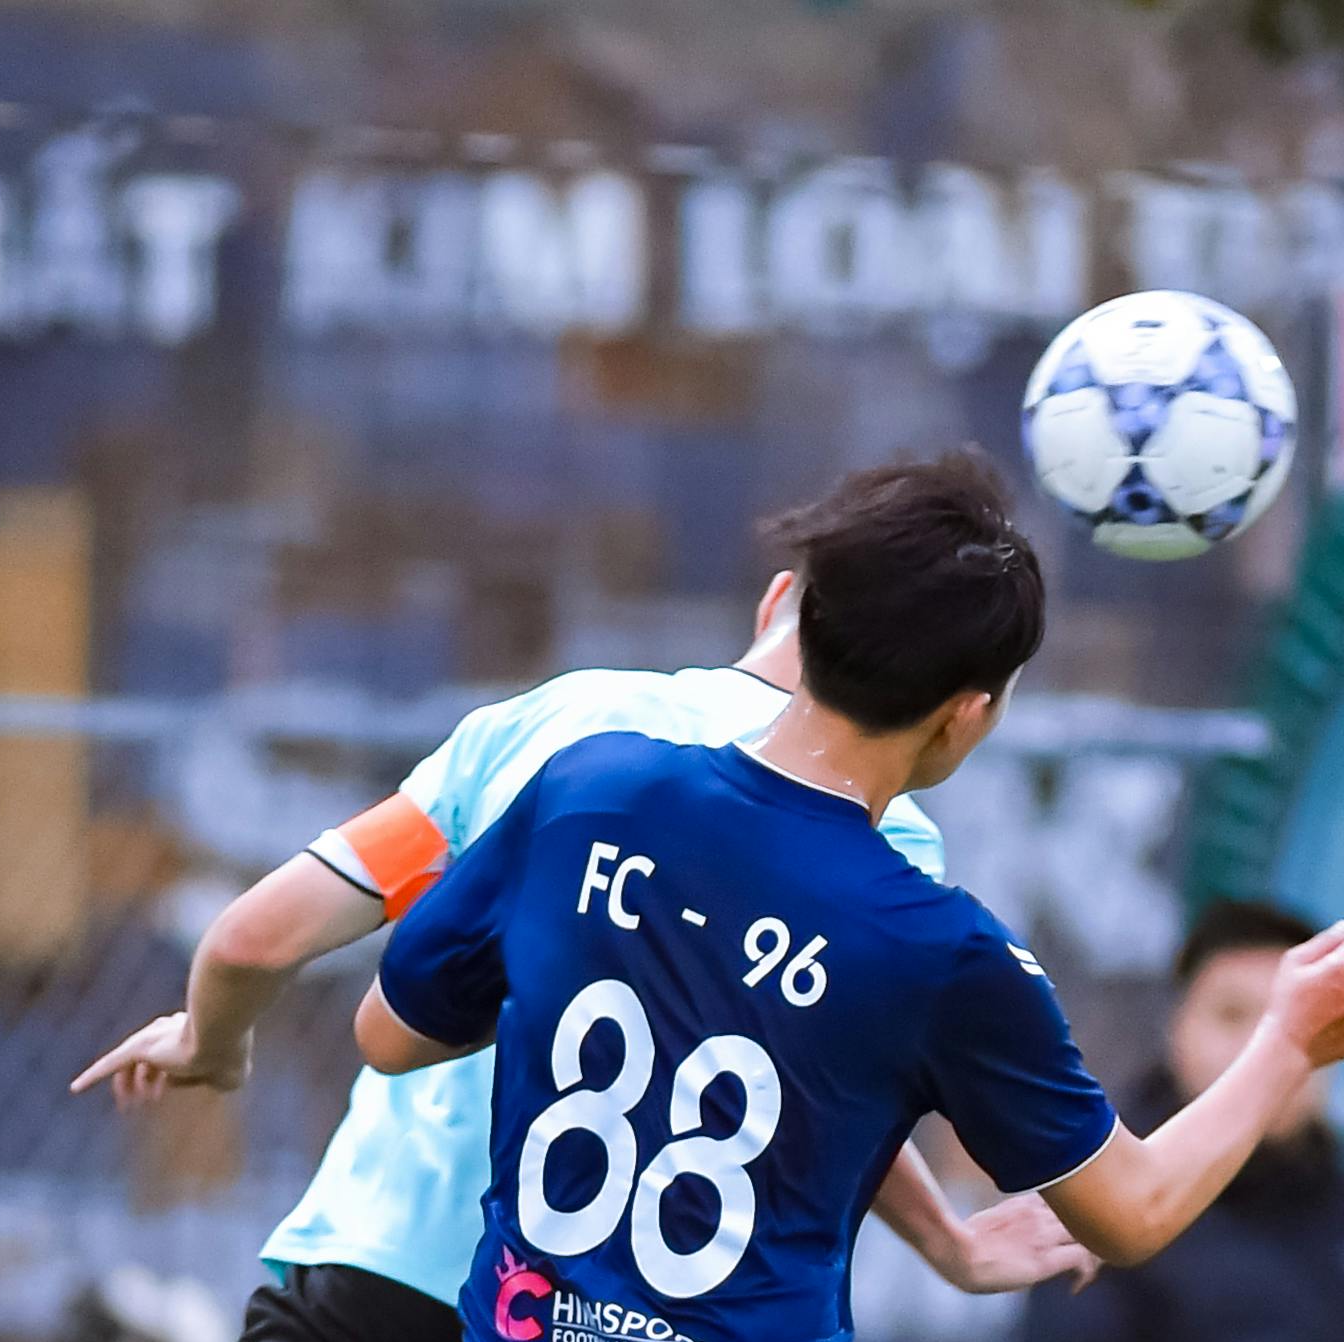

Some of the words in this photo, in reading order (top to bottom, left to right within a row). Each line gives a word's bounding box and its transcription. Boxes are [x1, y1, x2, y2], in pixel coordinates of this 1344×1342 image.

[576, 840, 656, 930] FC
[742, 916, 829, 1007] 96
[517, 977, 783, 1299] 88
